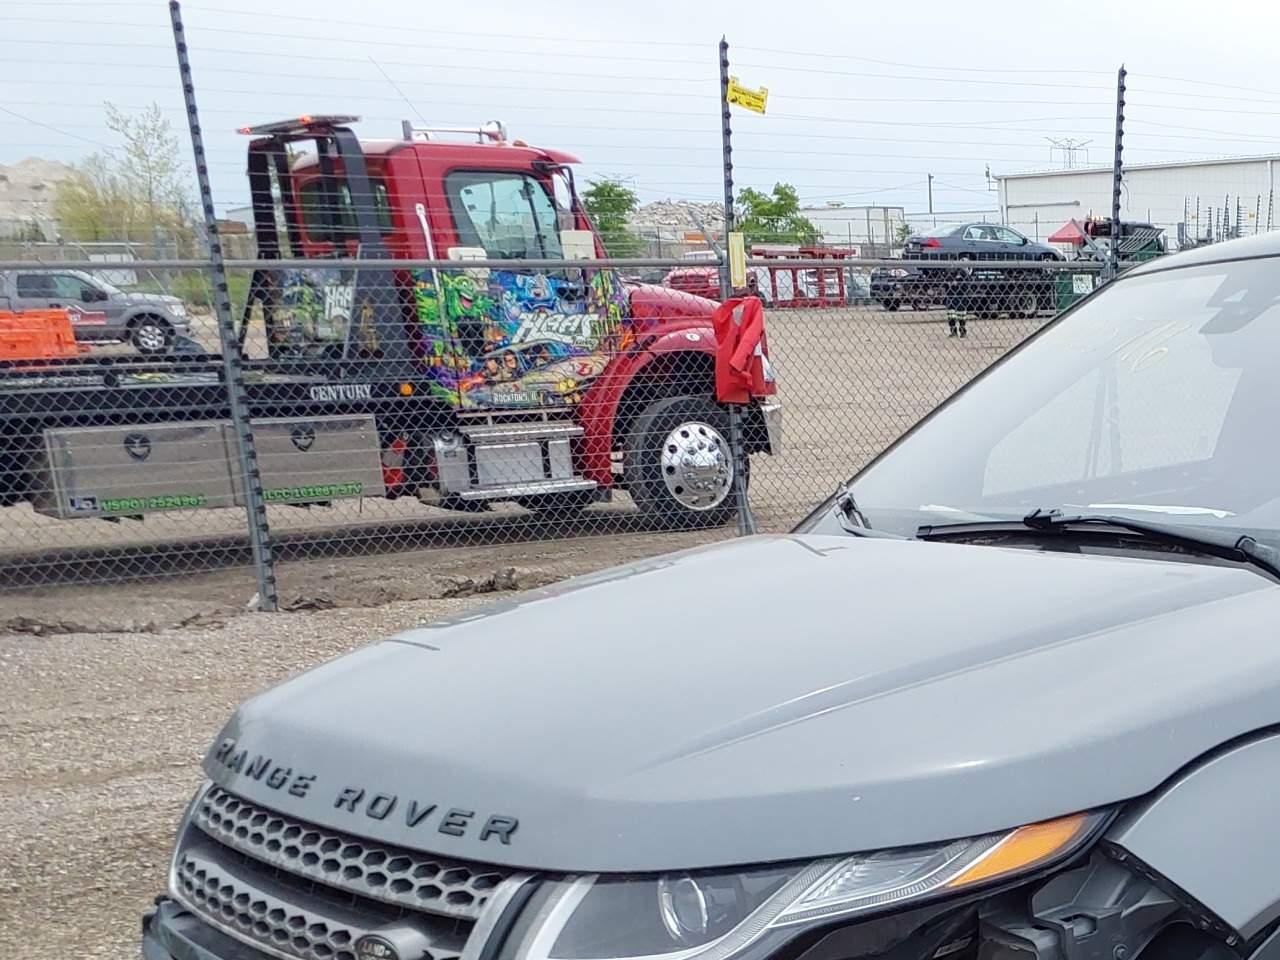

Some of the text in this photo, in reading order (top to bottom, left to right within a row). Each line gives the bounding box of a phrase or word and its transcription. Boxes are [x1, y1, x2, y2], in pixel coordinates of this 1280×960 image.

[309, 383, 372, 401] CENTURY
[100, 497, 145, 513] USDOT
[213, 739, 520, 846] RANGE ROVER
